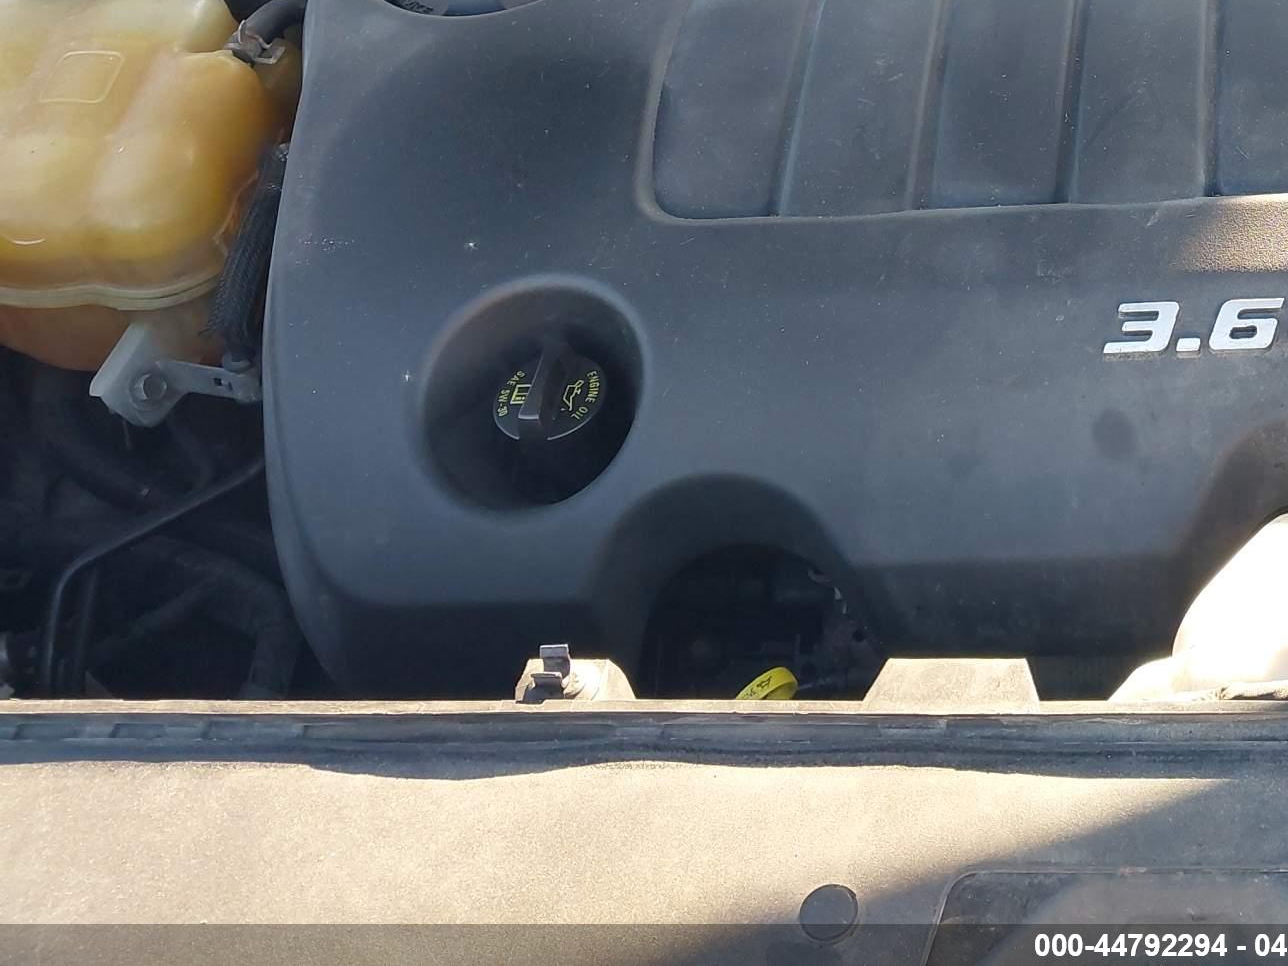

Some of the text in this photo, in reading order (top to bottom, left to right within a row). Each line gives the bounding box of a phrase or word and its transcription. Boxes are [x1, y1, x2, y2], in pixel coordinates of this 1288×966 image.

[497, 370, 525, 416] SAE 5W-30
[571, 370, 600, 420] ENGINE OIL
